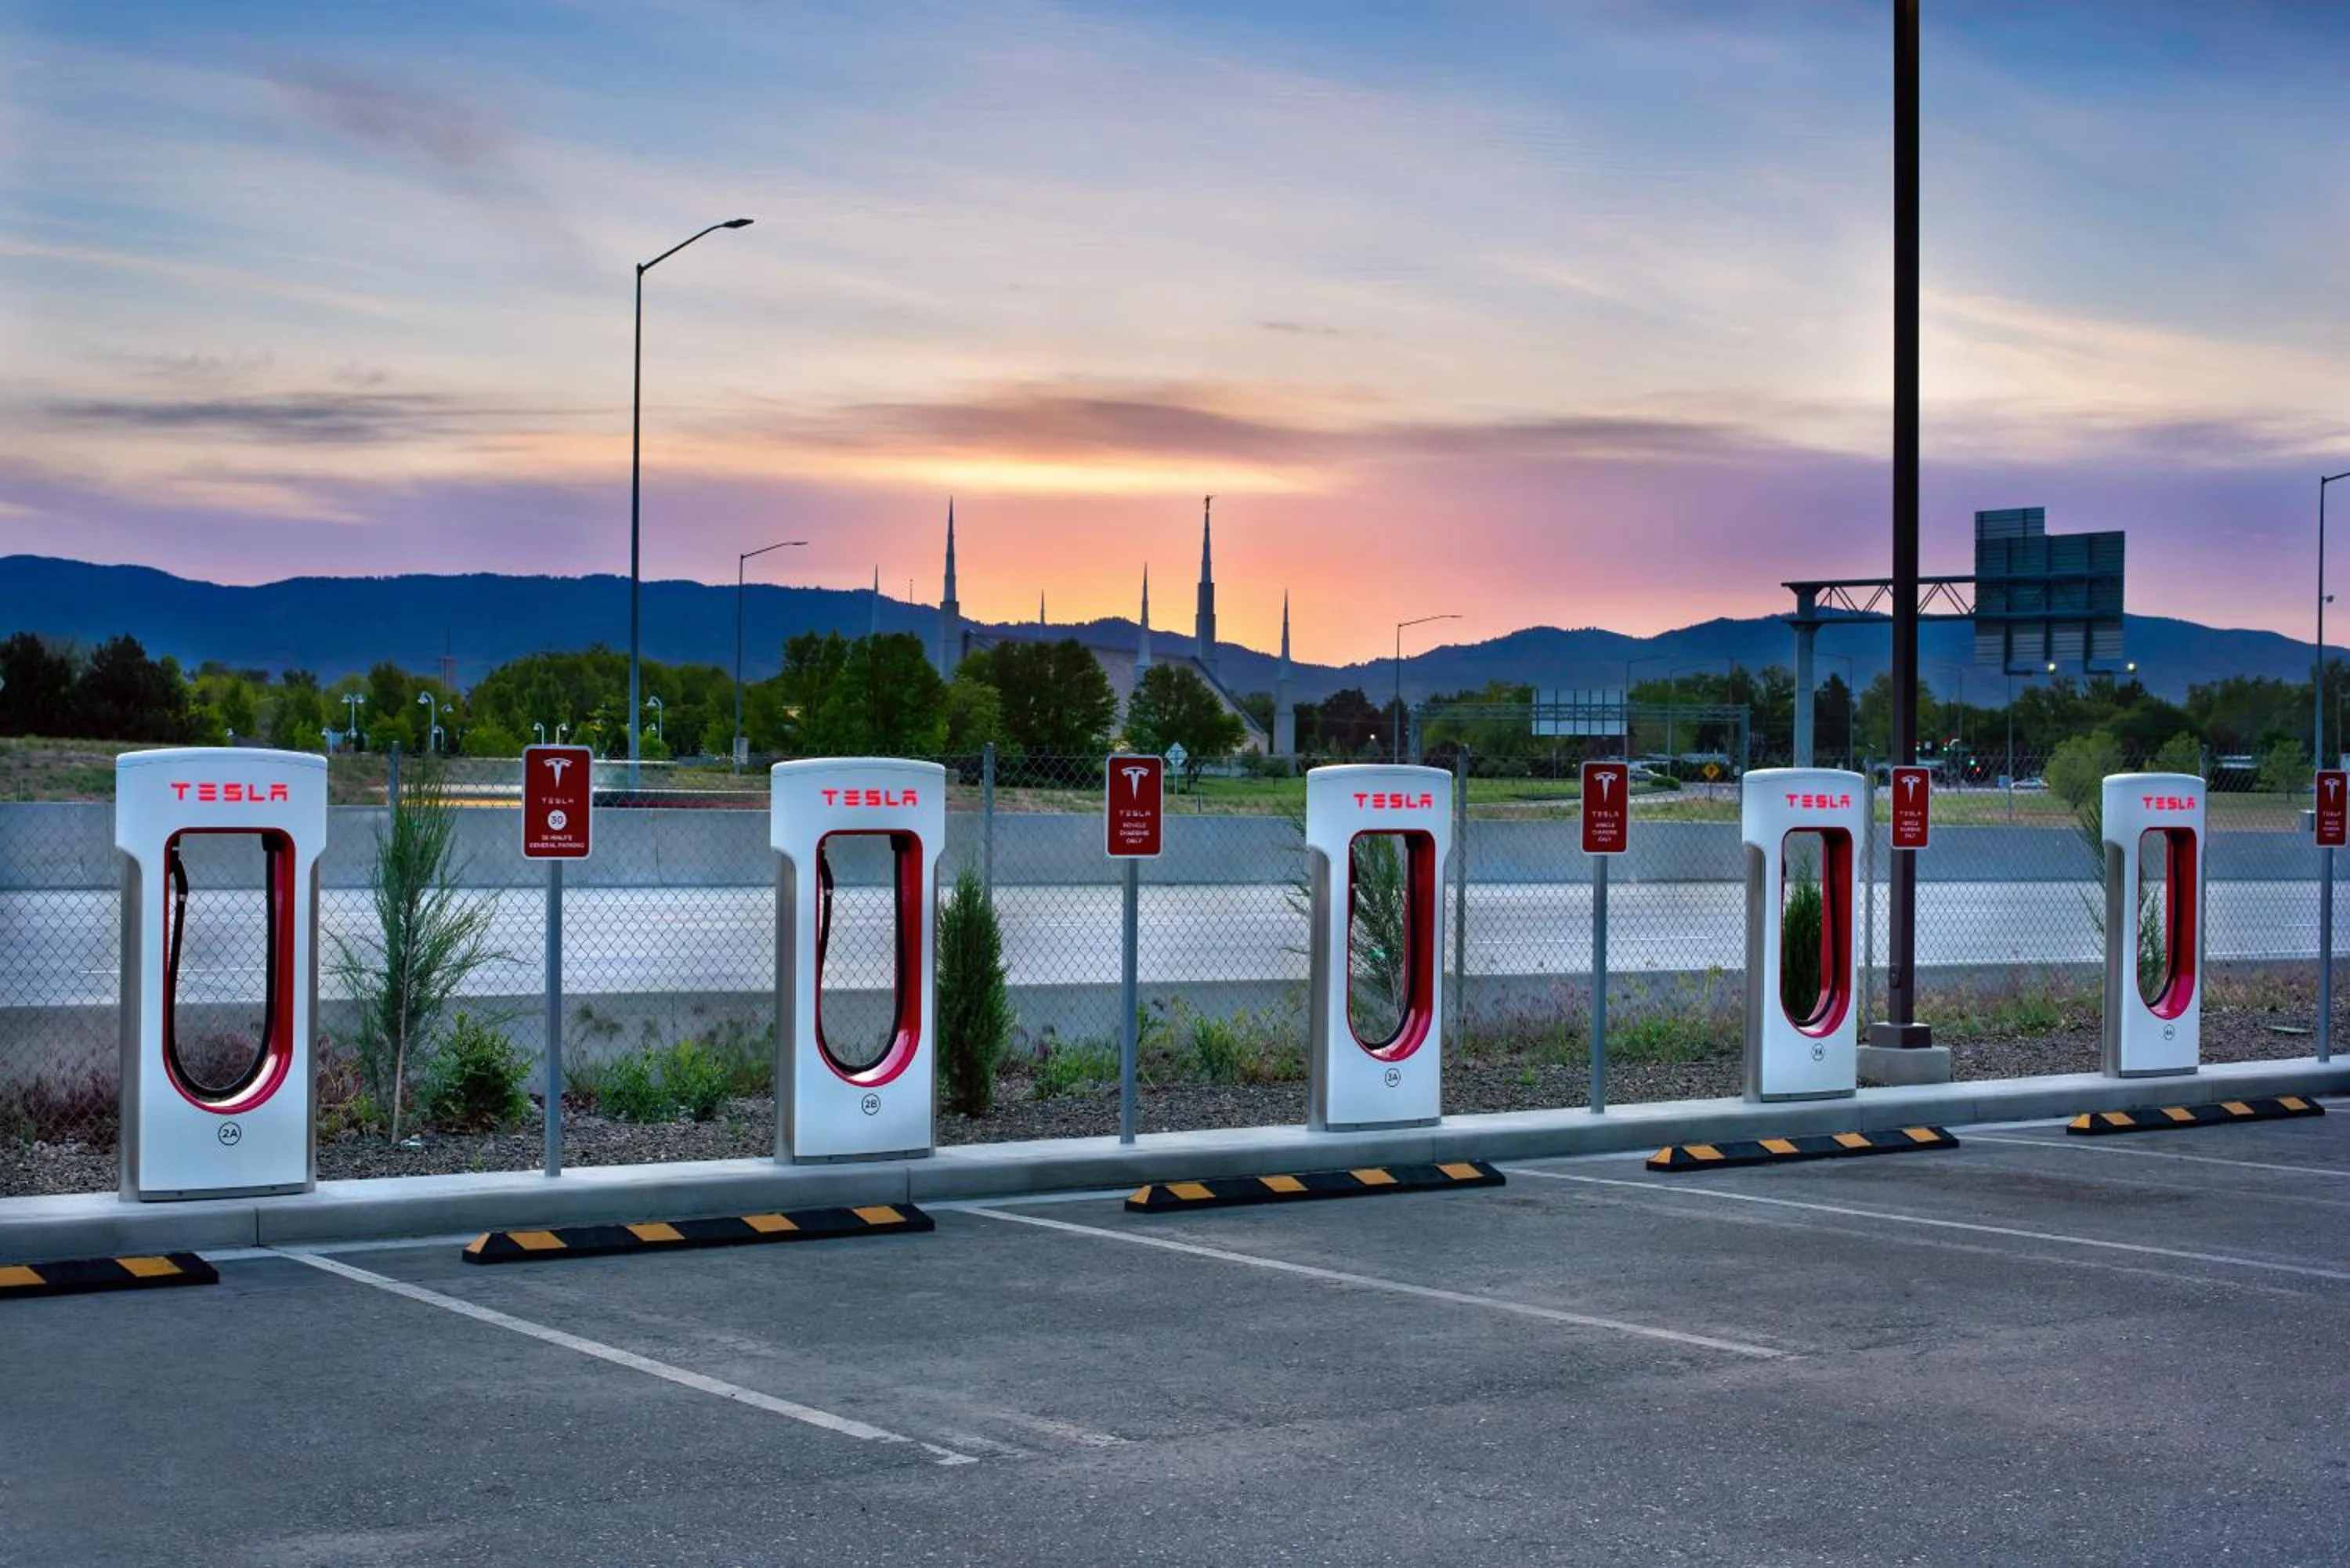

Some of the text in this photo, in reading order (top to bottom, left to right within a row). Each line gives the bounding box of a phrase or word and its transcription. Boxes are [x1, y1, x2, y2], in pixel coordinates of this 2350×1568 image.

[170, 783, 288, 801] TESLA
[821, 789, 918, 807] TESLA
[1354, 793, 1433, 809] TESLA
[1786, 793, 1850, 808] TESLA
[2142, 796, 2196, 810] TESLA
[551, 815, 563, 825] 30
[864, 1099, 877, 1108] 2B
[222, 1129, 238, 1138] 2A
